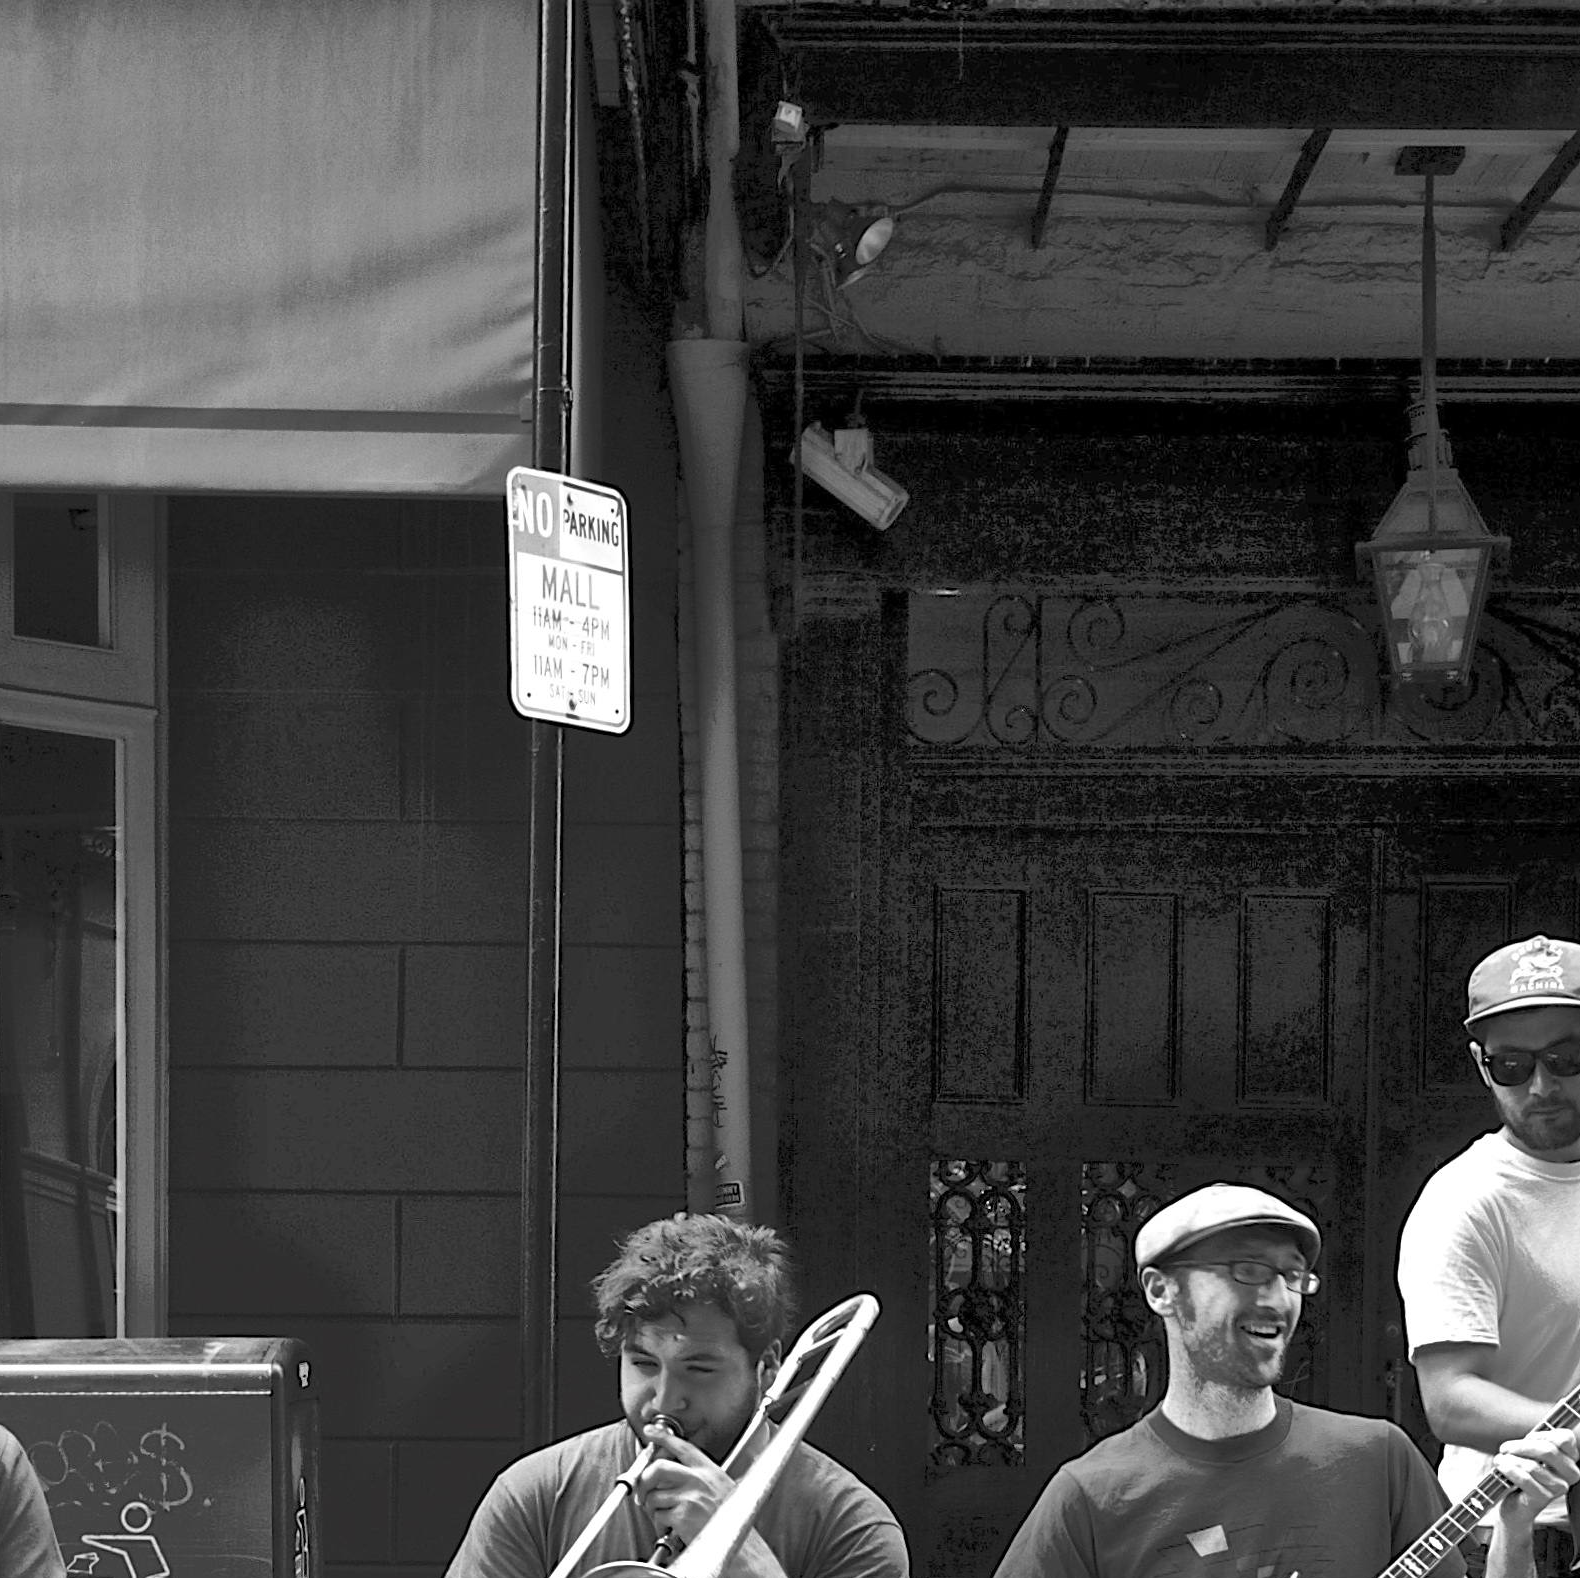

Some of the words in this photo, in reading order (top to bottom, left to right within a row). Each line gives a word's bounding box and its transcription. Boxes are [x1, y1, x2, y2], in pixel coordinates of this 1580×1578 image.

[517, 488, 553, 538] NO
[563, 509, 620, 548] PARKING
[541, 564, 601, 610] MALL
[532, 605, 563, 632] 11AM
[581, 614, 611, 641] 4PM
[548, 634, 567, 651] MON
[581, 640, 595, 657] FRI
[533, 654, 563, 680] 11AM
[582, 663, 611, 689] 7PM
[549, 683, 566, 700] SAT
[578, 689, 597, 706] SUN
